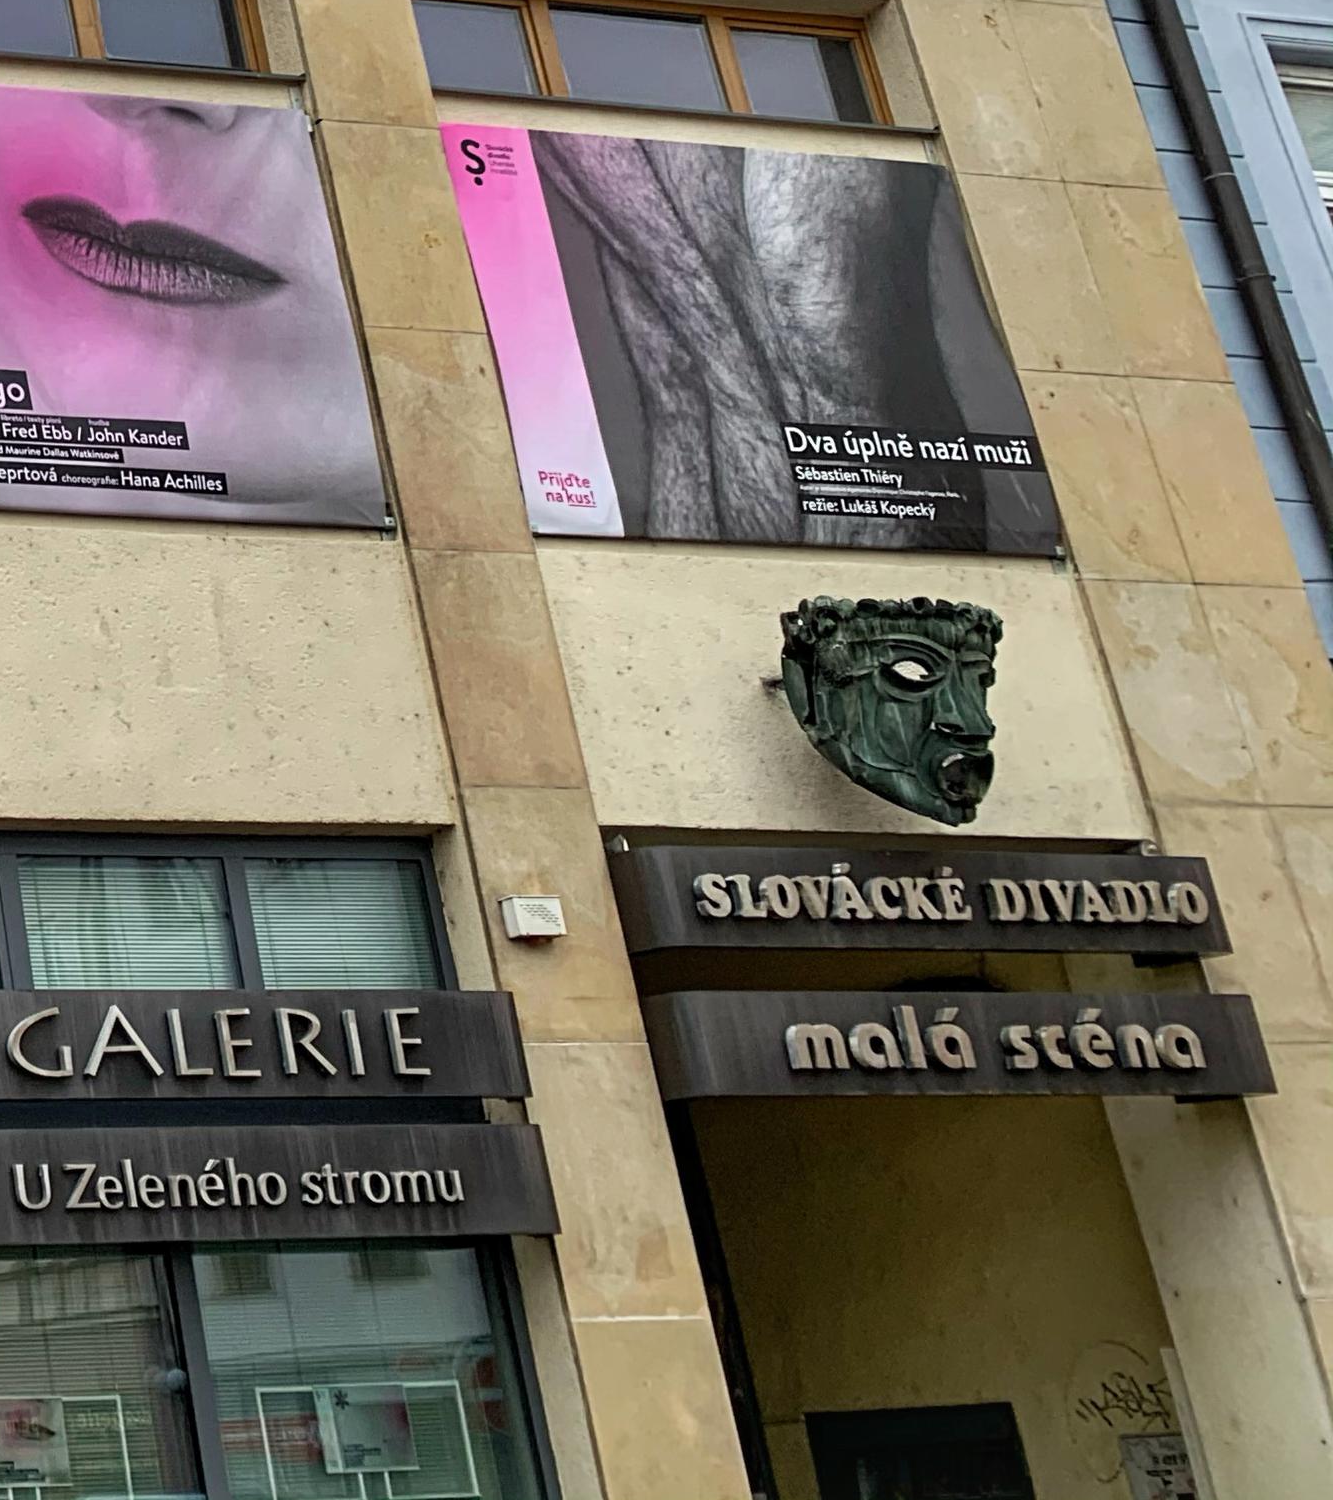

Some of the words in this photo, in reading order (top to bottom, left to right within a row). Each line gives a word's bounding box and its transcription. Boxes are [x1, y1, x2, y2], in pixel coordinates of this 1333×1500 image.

[2, 422, 38, 439] Fred
[41, 425, 73, 440] Ebb
[77, 427, 82, 441] /
[87, 426, 126, 443] John
[129, 429, 184, 446] Kander
[784, 426, 838, 454] Dva
[843, 430, 914, 463] úplně
[919, 437, 969, 461] nazí
[972, 440, 1033, 465] muži
[120, 470, 161, 488] Hana
[164, 473, 223, 492] Achilles
[795, 465, 861, 483] Sébastien
[861, 468, 903, 489] Thiéry
[545, 491, 564, 503] na
[565, 488, 597, 506] kus!
[802, 498, 839, 512] režie:
[840, 498, 879, 515] Lukáš
[880, 501, 936, 521] Kopecký
[694, 861, 973, 923] SLOVÁCKÉ
[984, 876, 1210, 926] DIVADLO
[6, 1004, 433, 1079] GALERIE
[785, 1004, 977, 1071] malá
[999, 1007, 1208, 1071] scéna
[11, 1163, 53, 1211] U
[62, 1156, 289, 1211] Zeleného
[300, 1162, 466, 1207] stromu
